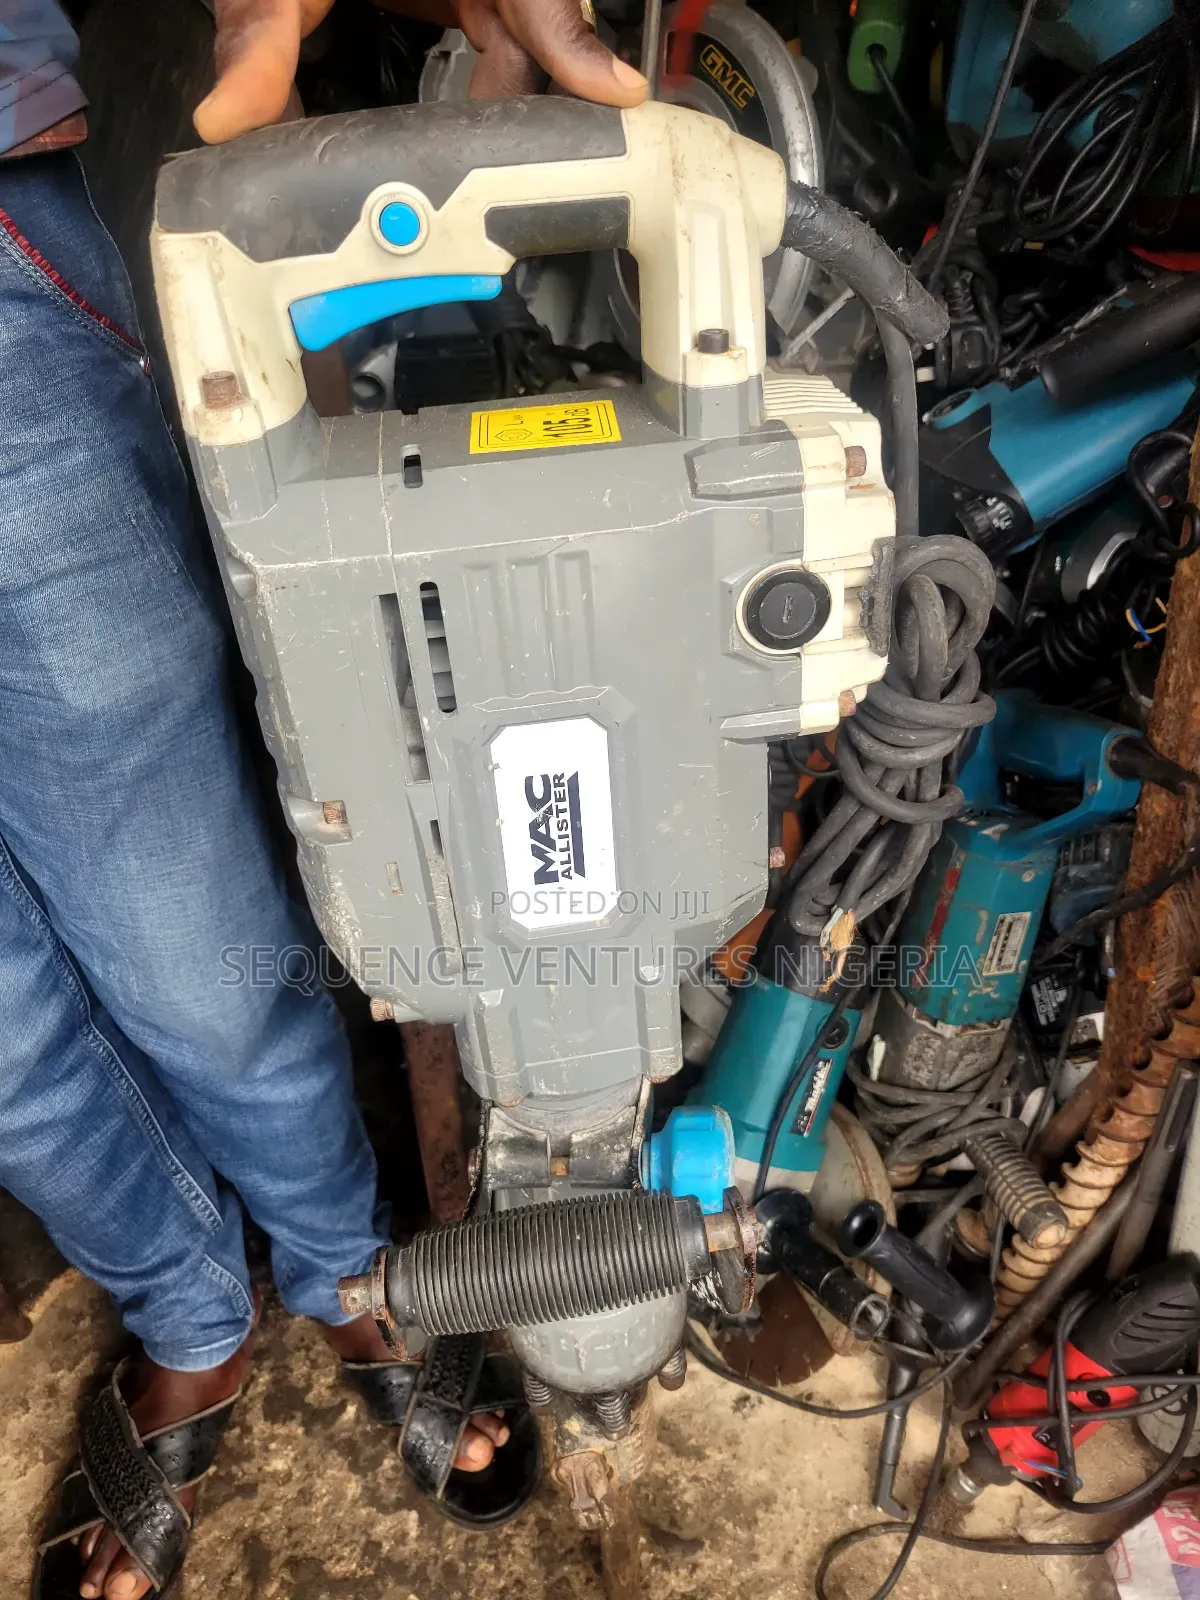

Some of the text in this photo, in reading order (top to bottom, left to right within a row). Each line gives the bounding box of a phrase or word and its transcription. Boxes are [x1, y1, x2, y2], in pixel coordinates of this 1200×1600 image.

[700, 44, 755, 108] GMC
[543, 417, 593, 438] 105
[524, 773, 560, 885] MAC
[552, 772, 573, 880] ALLISTER
